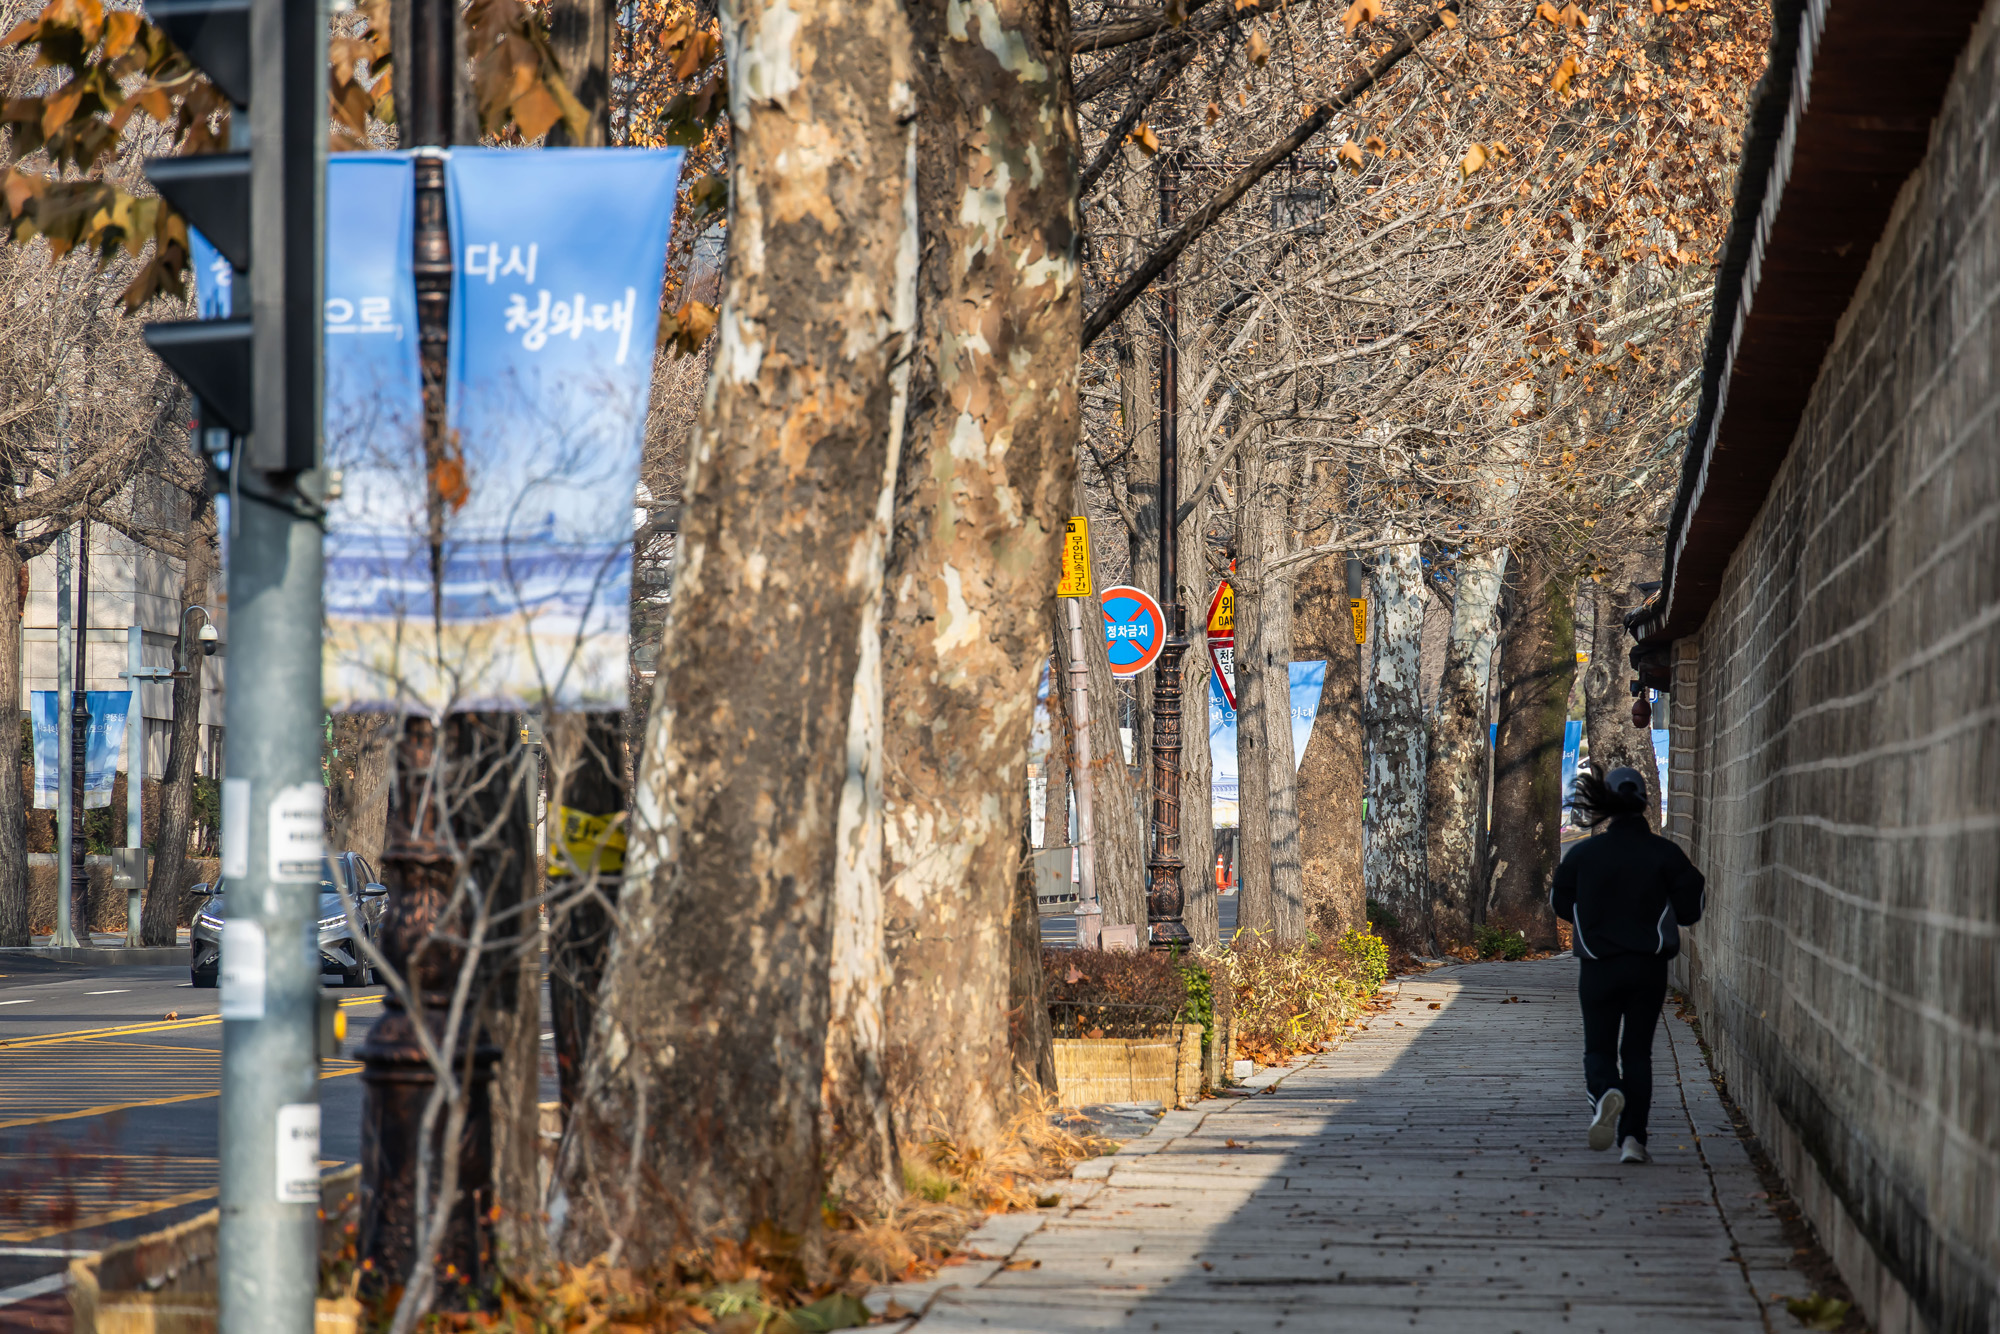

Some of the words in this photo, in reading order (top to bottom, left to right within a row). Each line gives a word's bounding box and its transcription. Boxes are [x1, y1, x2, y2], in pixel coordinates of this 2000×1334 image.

[464, 241, 538, 285] 다시
[504, 286, 637, 366] 청와대
[1072, 535, 1086, 592] 무인단속구간
